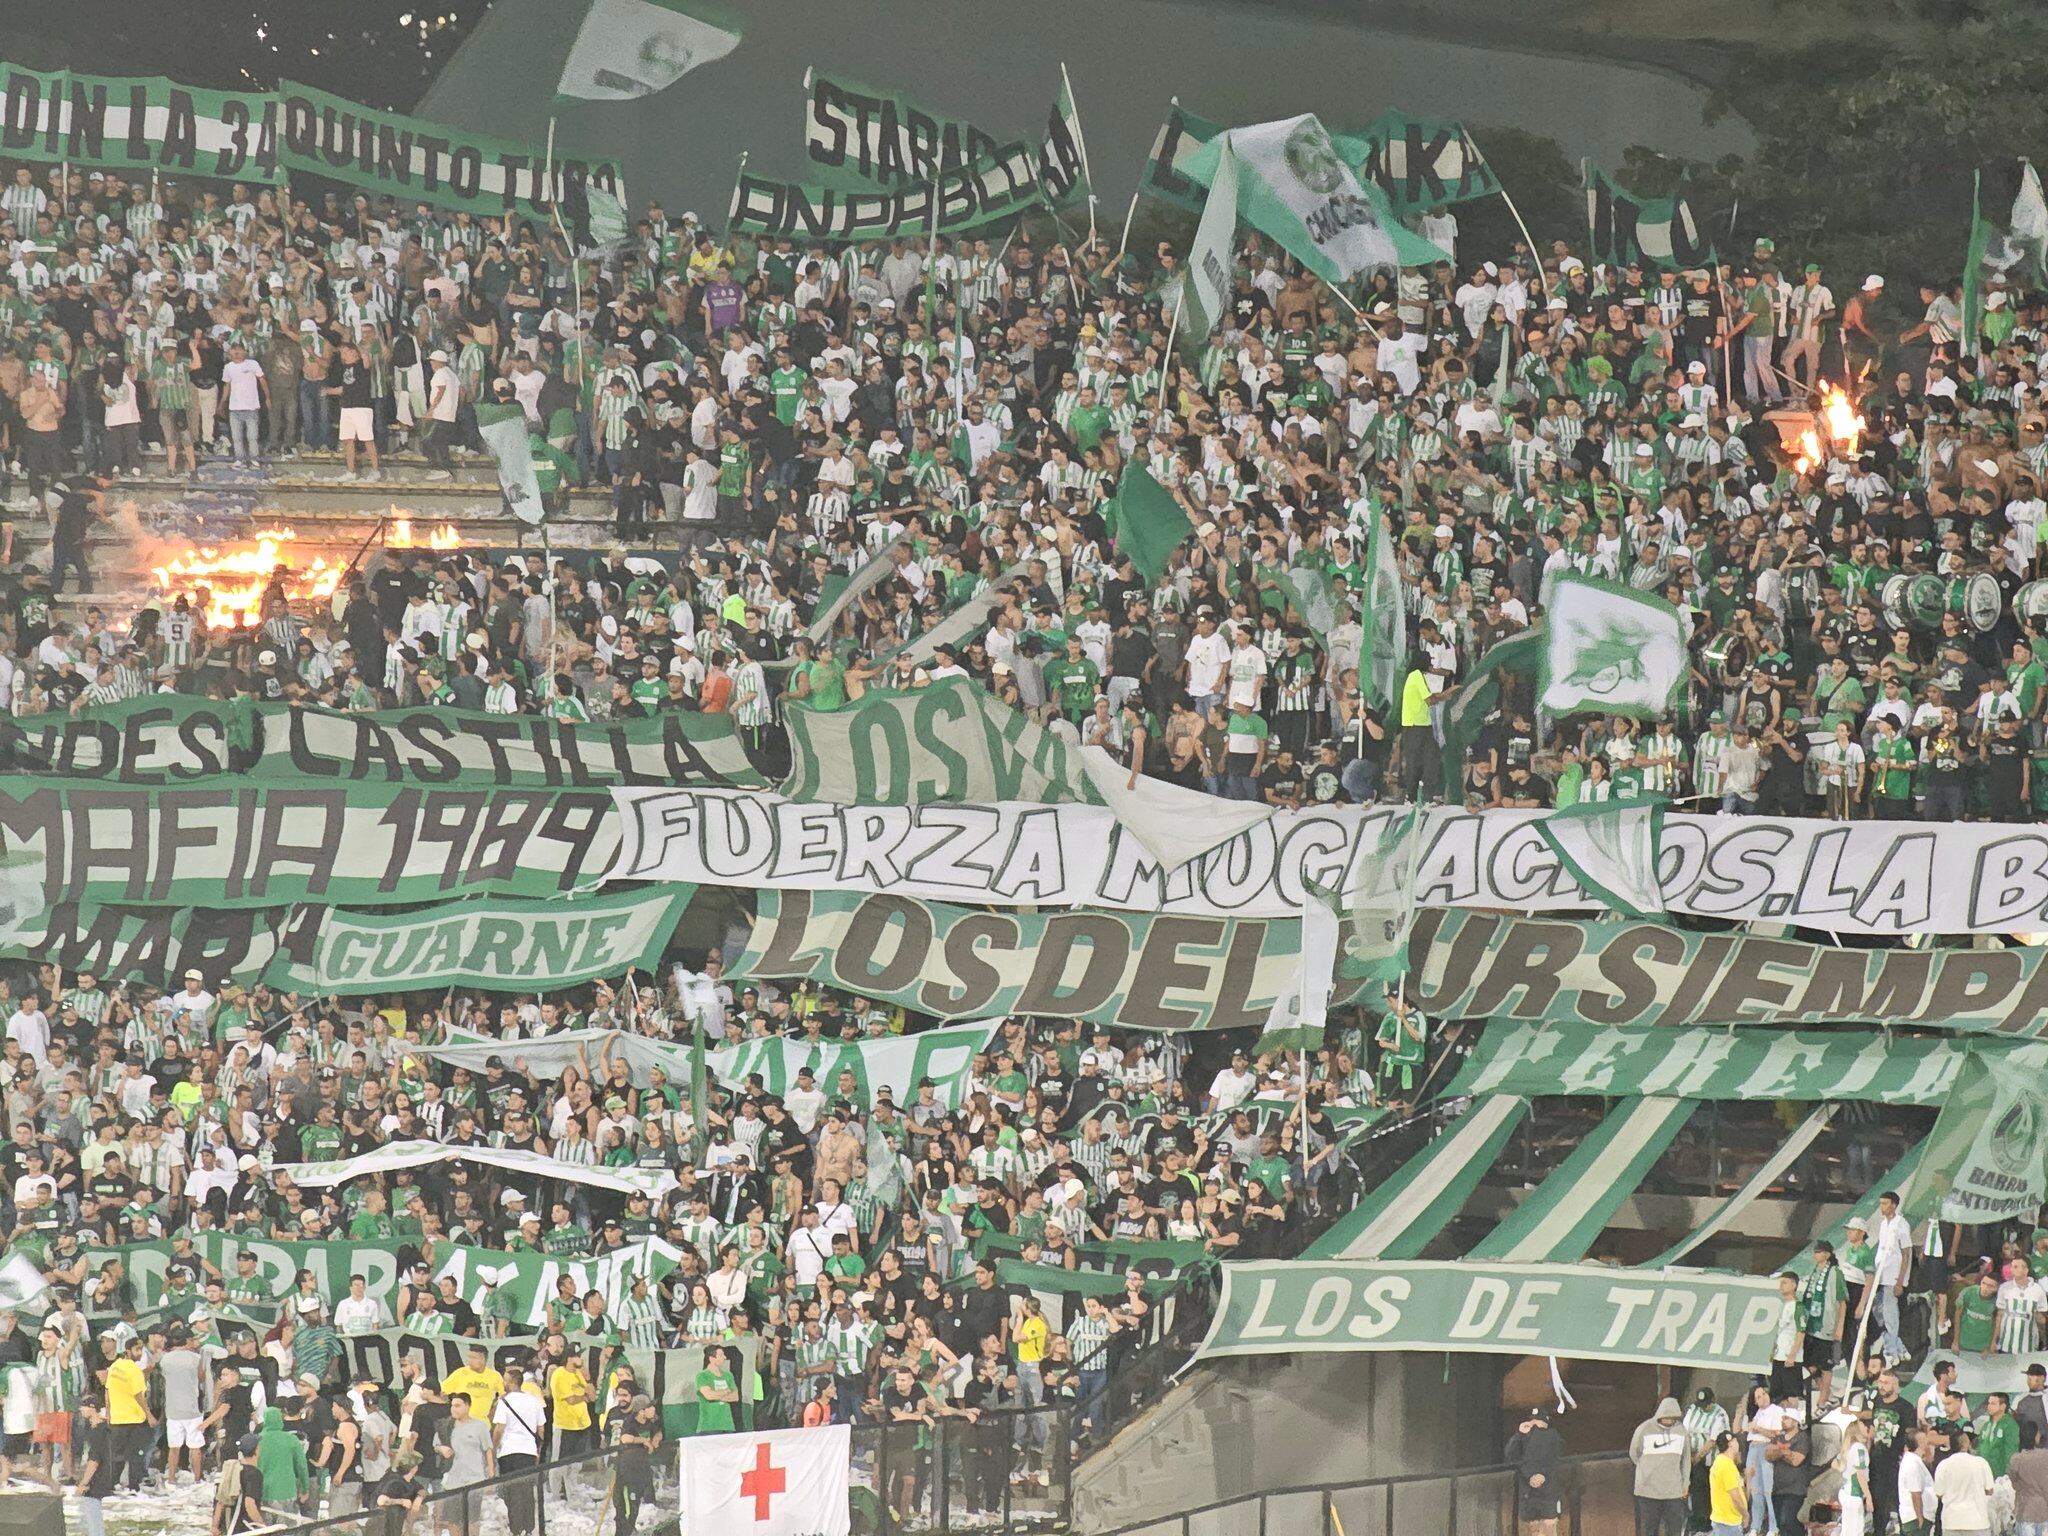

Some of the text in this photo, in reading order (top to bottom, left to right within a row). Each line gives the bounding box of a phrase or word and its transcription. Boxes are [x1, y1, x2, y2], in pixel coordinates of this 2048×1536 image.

[127, 85, 197, 168] LA
[214, 99, 277, 179] 34
[284, 95, 484, 198] QUINTO
[0, 788, 614, 901] MAFIA 1989
[624, 792, 1066, 900] FUERZA
[1967, 833, 2048, 929] B
[326, 912, 634, 984] GUARNE
[1240, 1275, 1412, 1340] LOS
[1449, 1280, 1562, 1342] DE
[1599, 1286, 1780, 1357] TRAP
